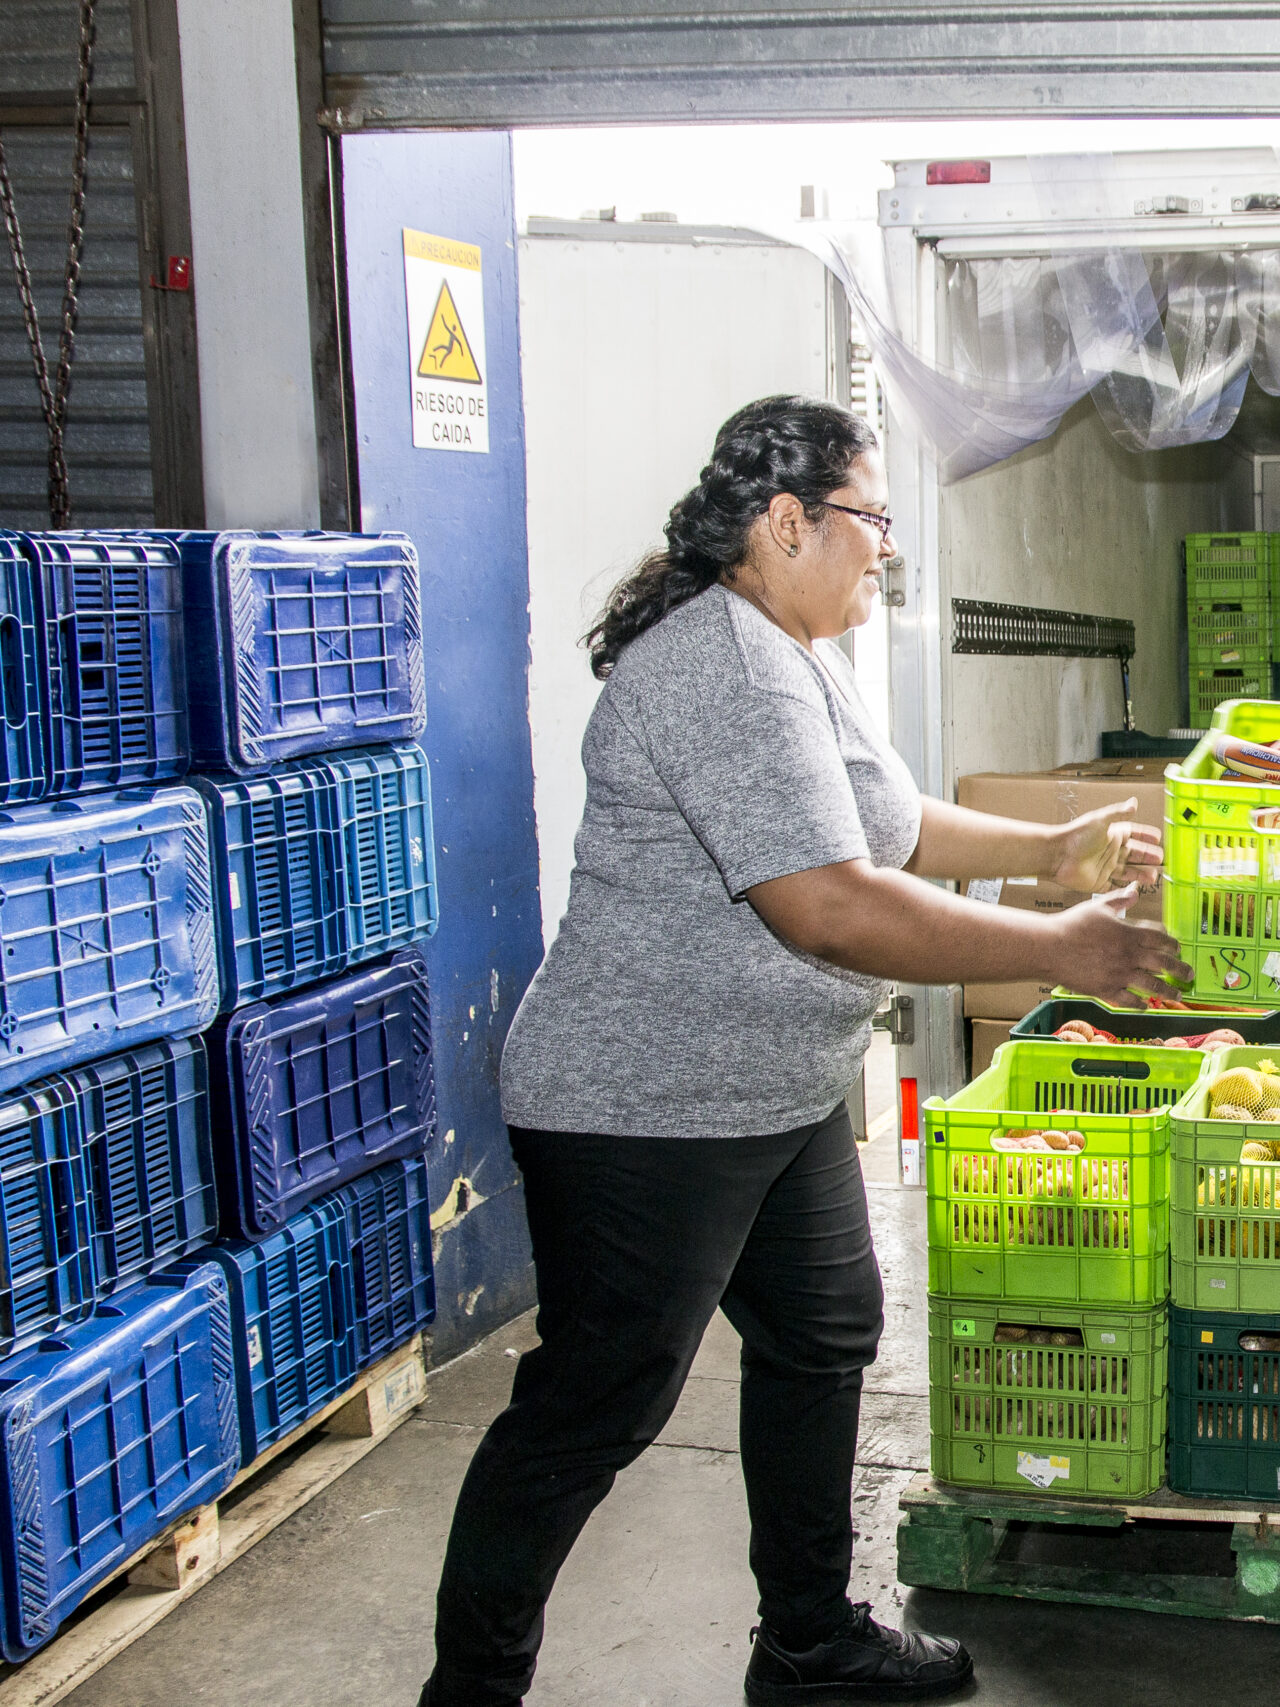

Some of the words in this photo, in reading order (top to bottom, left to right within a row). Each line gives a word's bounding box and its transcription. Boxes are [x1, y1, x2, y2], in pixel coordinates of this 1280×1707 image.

[421, 240, 479, 267] PRECAUCION
[416, 391, 464, 415] RIESGO
[468, 397, 485, 417] DE
[432, 422, 472, 444] CAIDA
